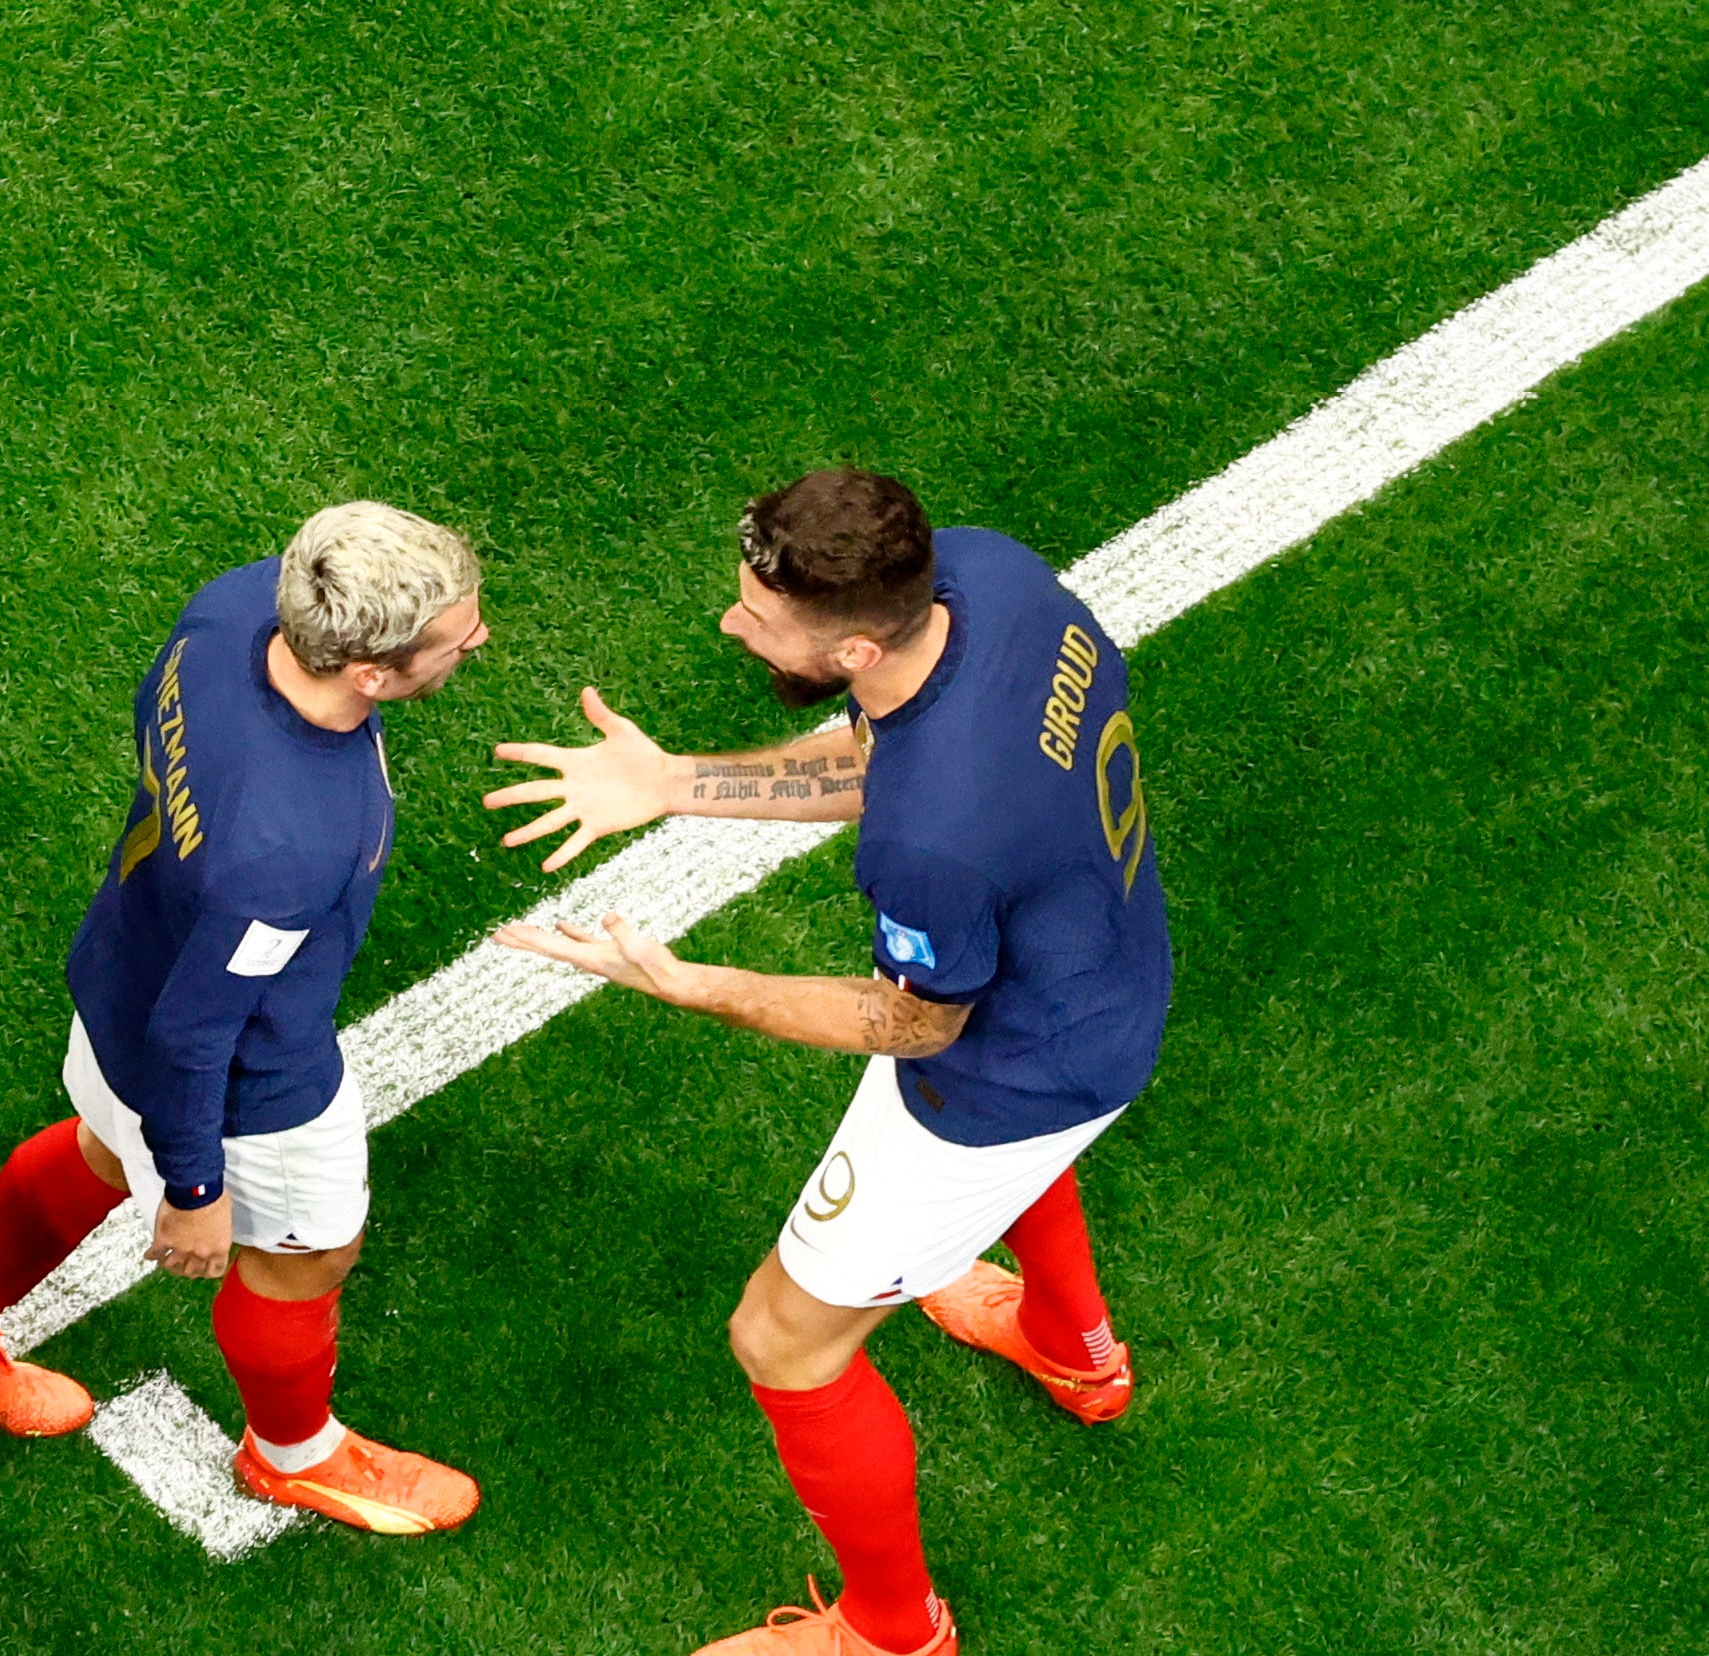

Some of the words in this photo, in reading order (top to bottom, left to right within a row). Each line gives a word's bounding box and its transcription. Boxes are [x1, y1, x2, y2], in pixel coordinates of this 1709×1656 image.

[1039, 624, 1098, 771] GIROUD
[1096, 710, 1146, 901] 9
[804, 1151, 855, 1222] 9
